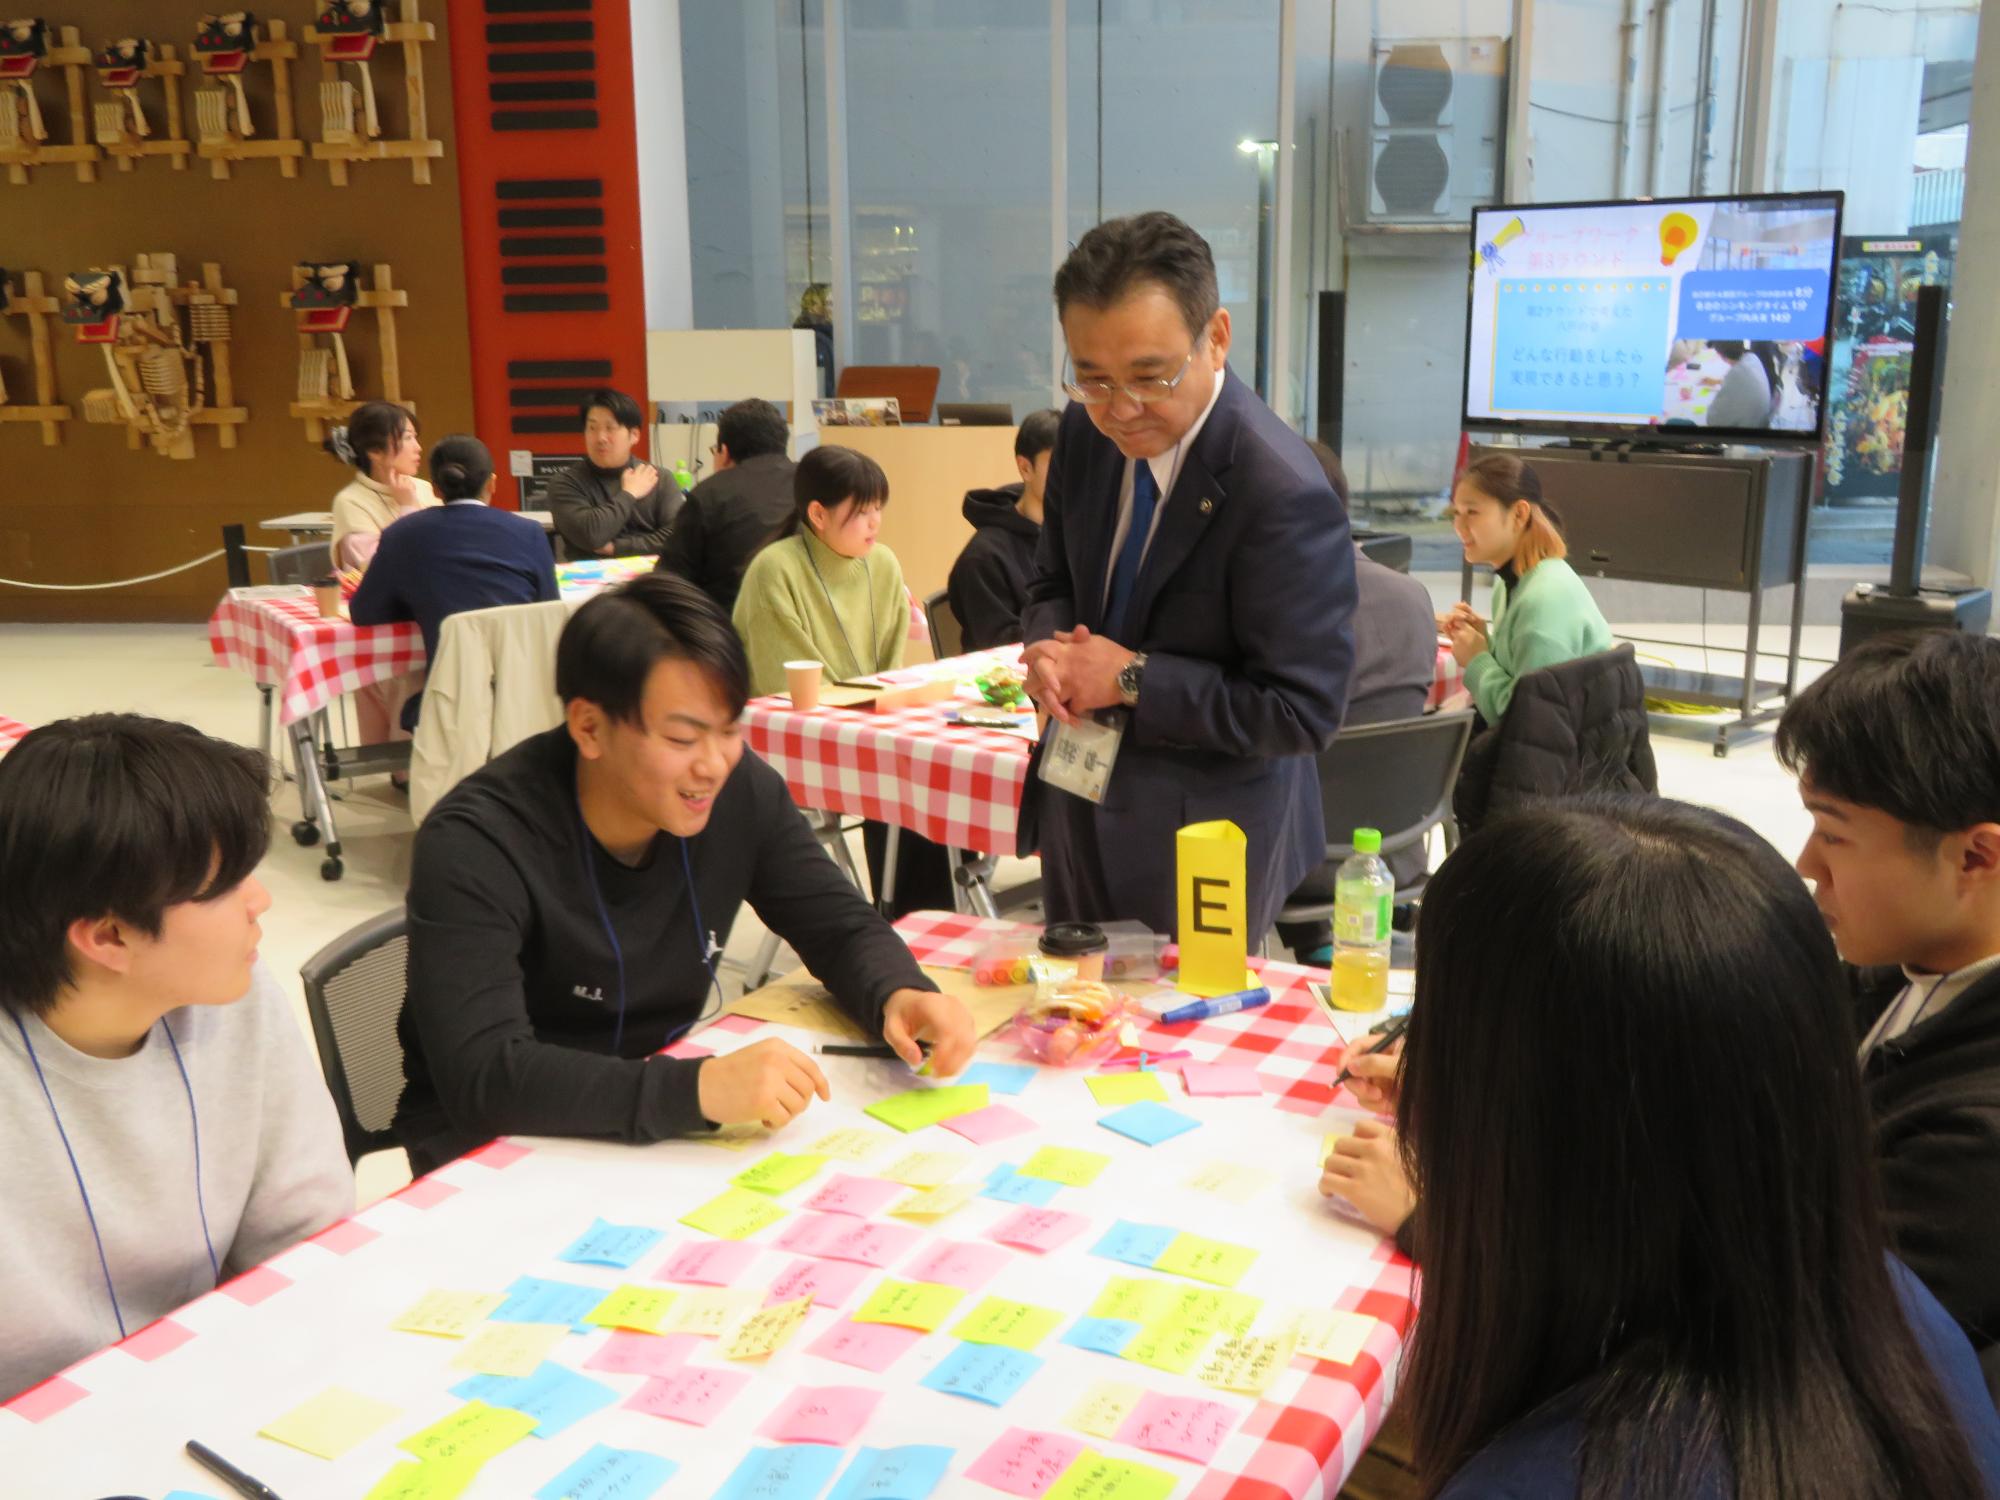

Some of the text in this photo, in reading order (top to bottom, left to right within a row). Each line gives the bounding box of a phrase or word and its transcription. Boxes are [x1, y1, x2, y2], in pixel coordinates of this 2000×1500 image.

[1512, 345, 1644, 365] どんな行動をしたら
[1193, 876, 1233, 936] E
